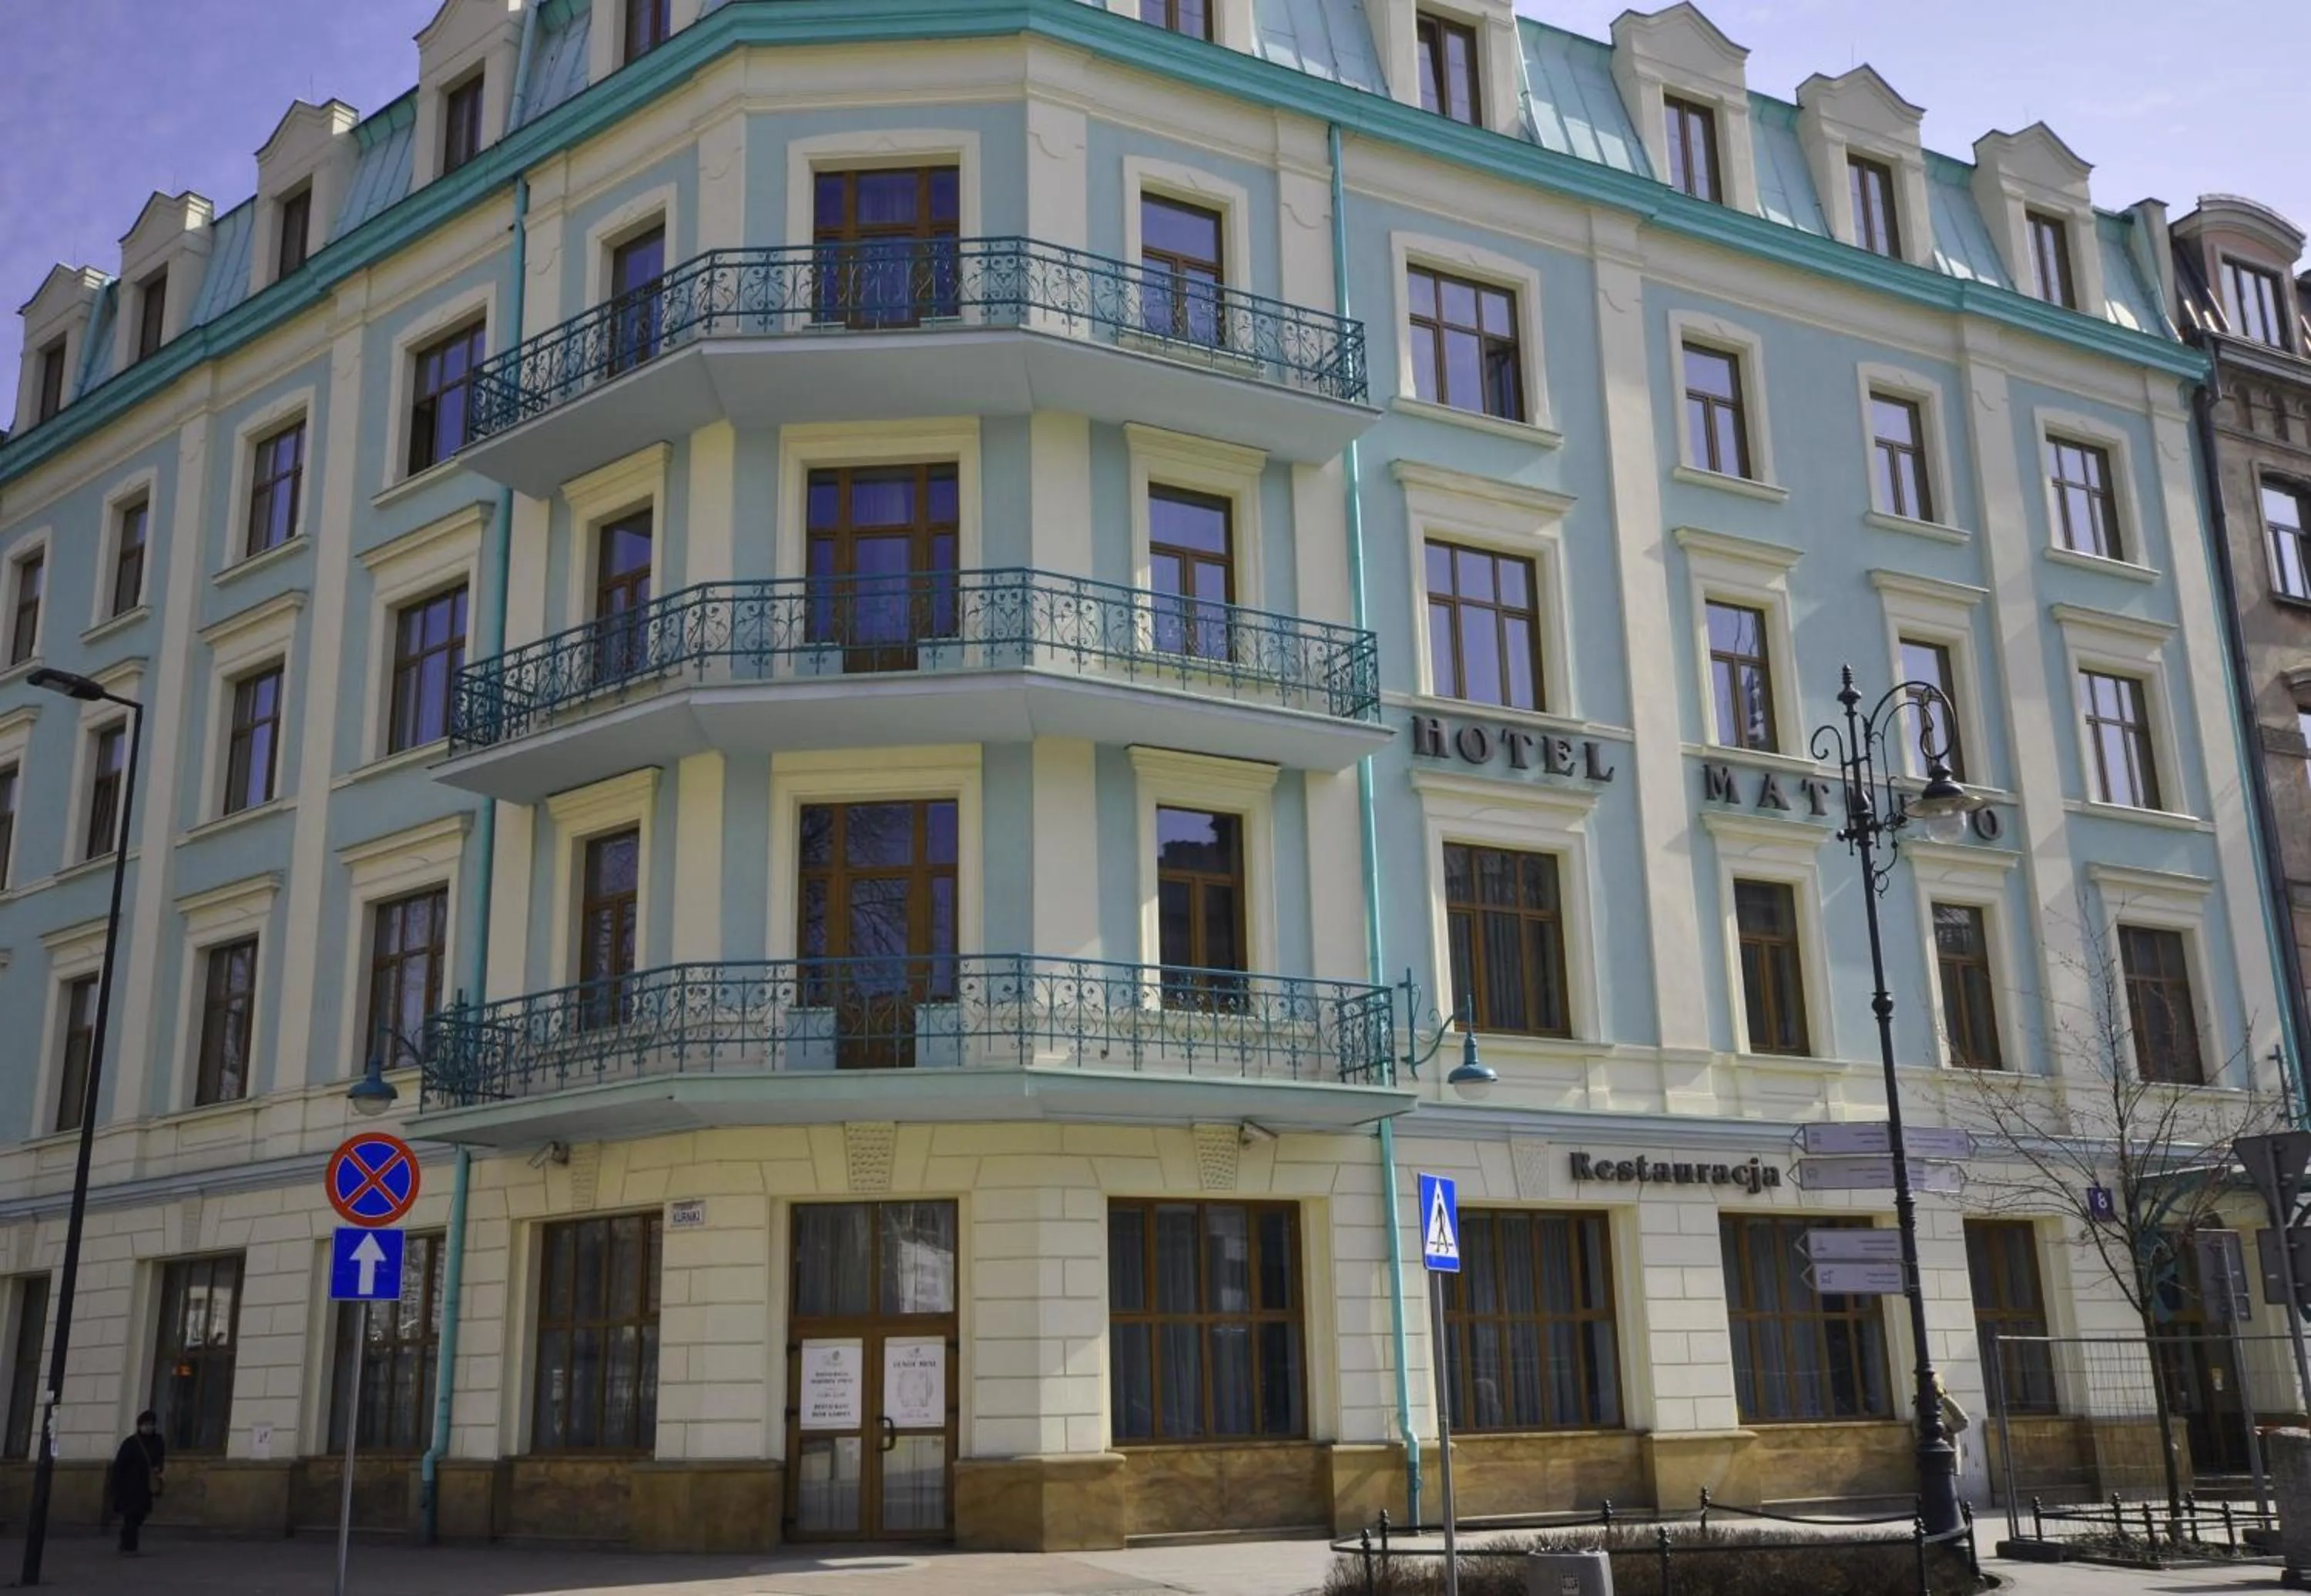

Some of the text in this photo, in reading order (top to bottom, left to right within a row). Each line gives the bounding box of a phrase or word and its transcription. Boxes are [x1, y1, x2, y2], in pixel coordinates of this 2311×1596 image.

[1411, 715, 2004, 841] HOTEL MATO
[1569, 1152, 1782, 1193] Restauracja
